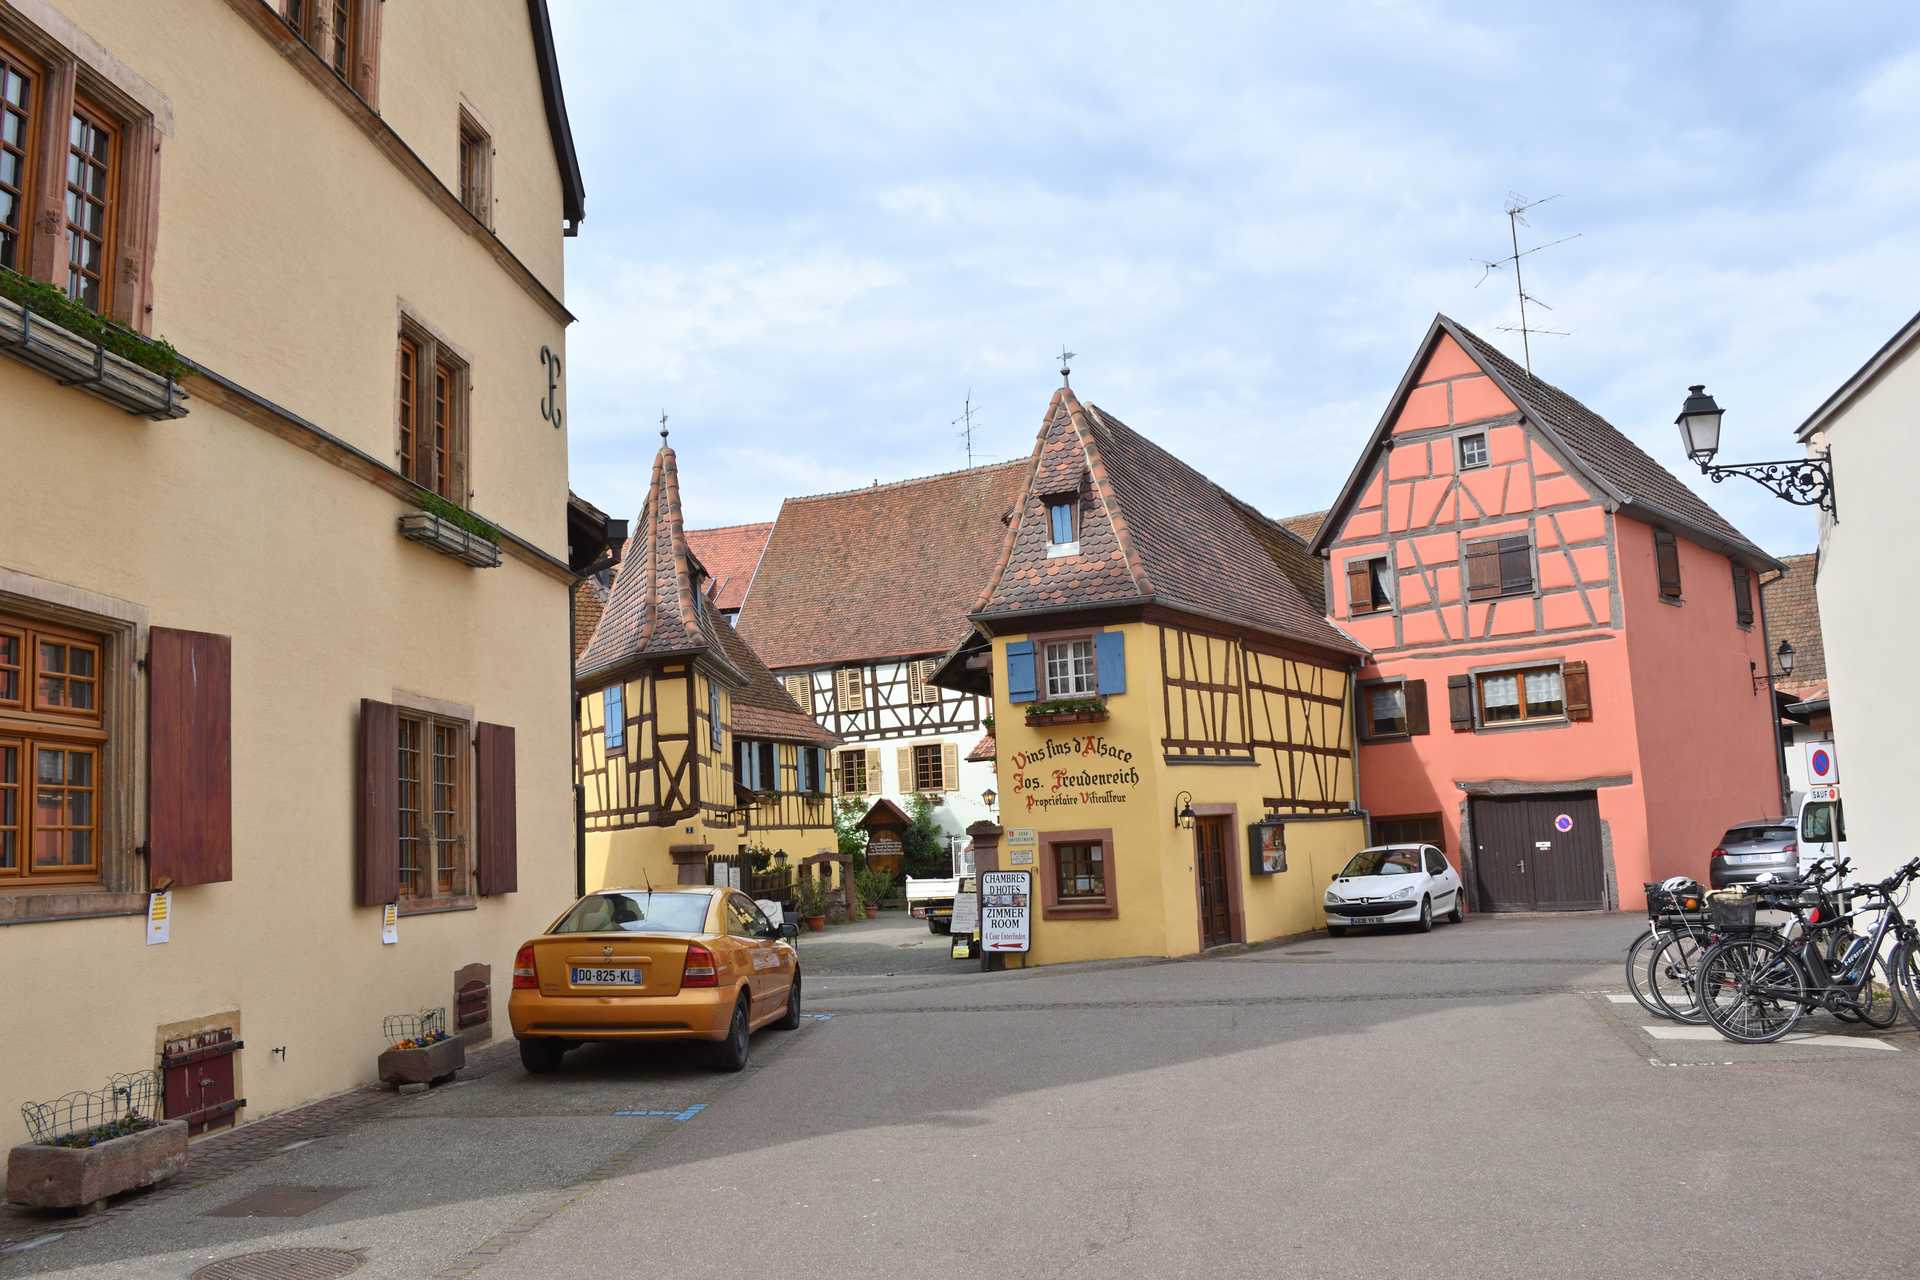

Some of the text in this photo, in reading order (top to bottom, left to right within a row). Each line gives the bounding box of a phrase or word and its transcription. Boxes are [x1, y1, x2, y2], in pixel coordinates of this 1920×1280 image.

[1011, 736, 1132, 769] Vins fins d'Alsace
[1013, 766, 1139, 793] Jos. Freudenreich
[1080, 790, 1126, 804] Viticulteur
[1812, 790, 1828, 799] SAUF
[984, 873, 1026, 884] CHAMBRES
[986, 908, 1024, 918] ZIMMER
[991, 919, 1020, 929] ROOM
